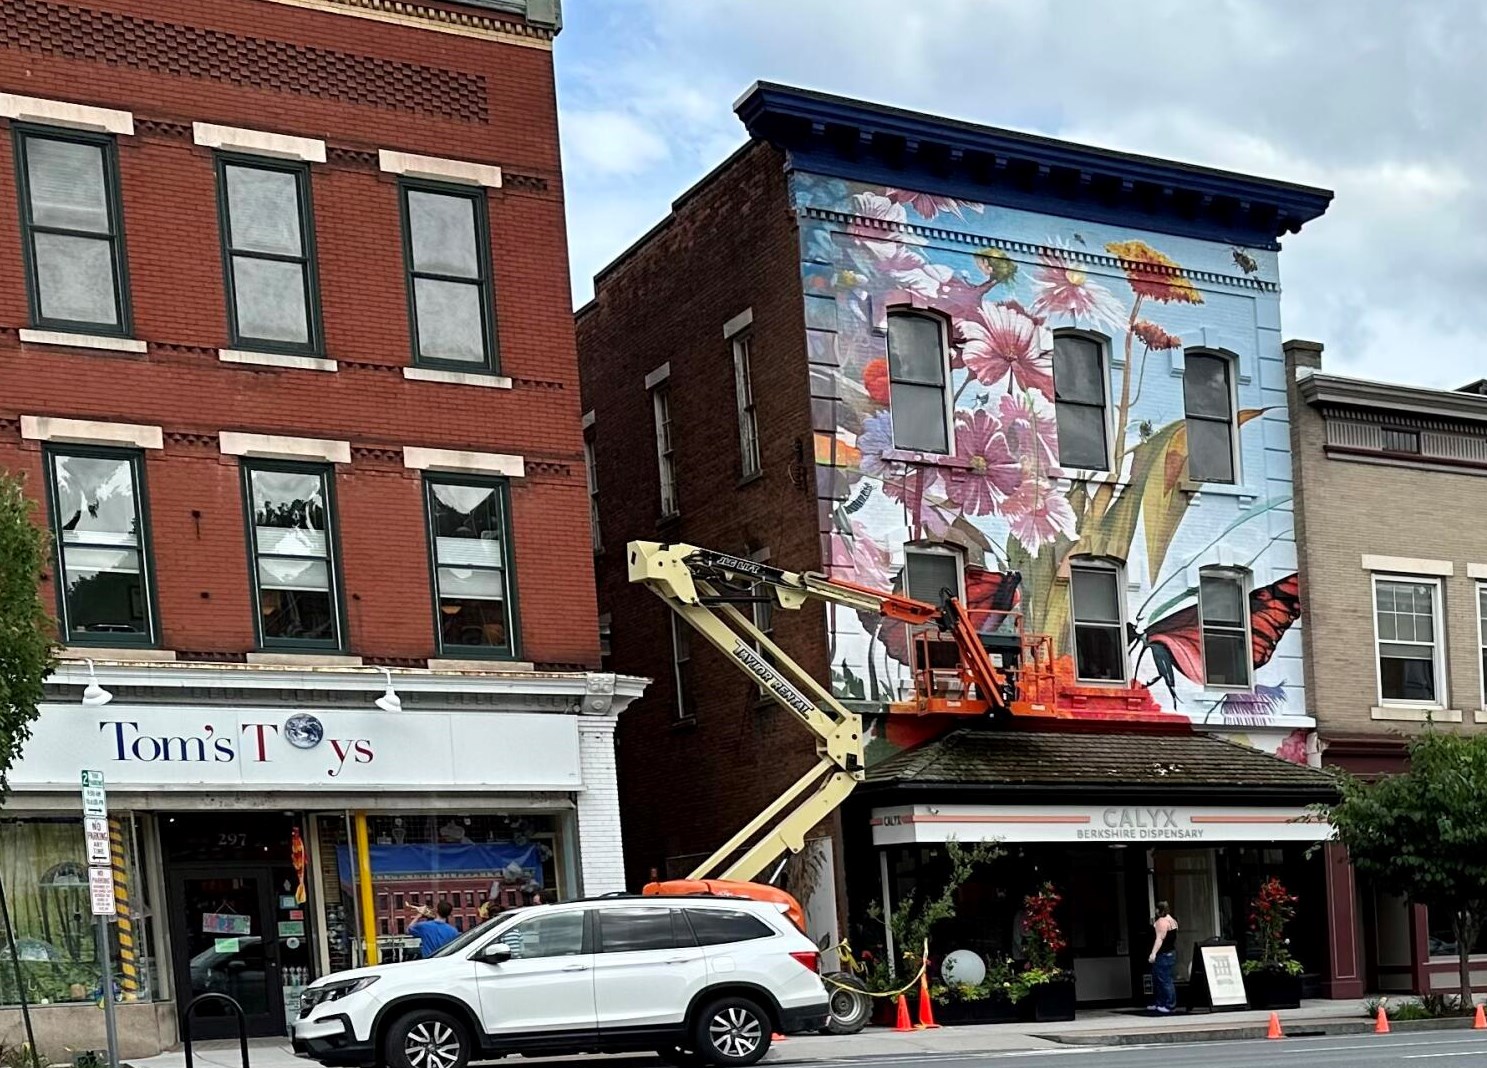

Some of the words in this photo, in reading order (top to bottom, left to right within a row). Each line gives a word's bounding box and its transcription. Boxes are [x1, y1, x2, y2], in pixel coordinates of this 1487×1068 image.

[737, 561, 761, 575] LIFT
[732, 638, 774, 680] TAYLOR
[770, 677, 816, 721] RENTAL
[99, 721, 235, 763] Tom's
[1103, 808, 1179, 829] CALYX
[92, 822, 102, 832] NO
[1077, 829, 1136, 839] BERKSHIRE
[1140, 829, 1204, 839] DISPENSARY
[87, 832, 108, 841] PARKING
[218, 833, 247, 847] 297
